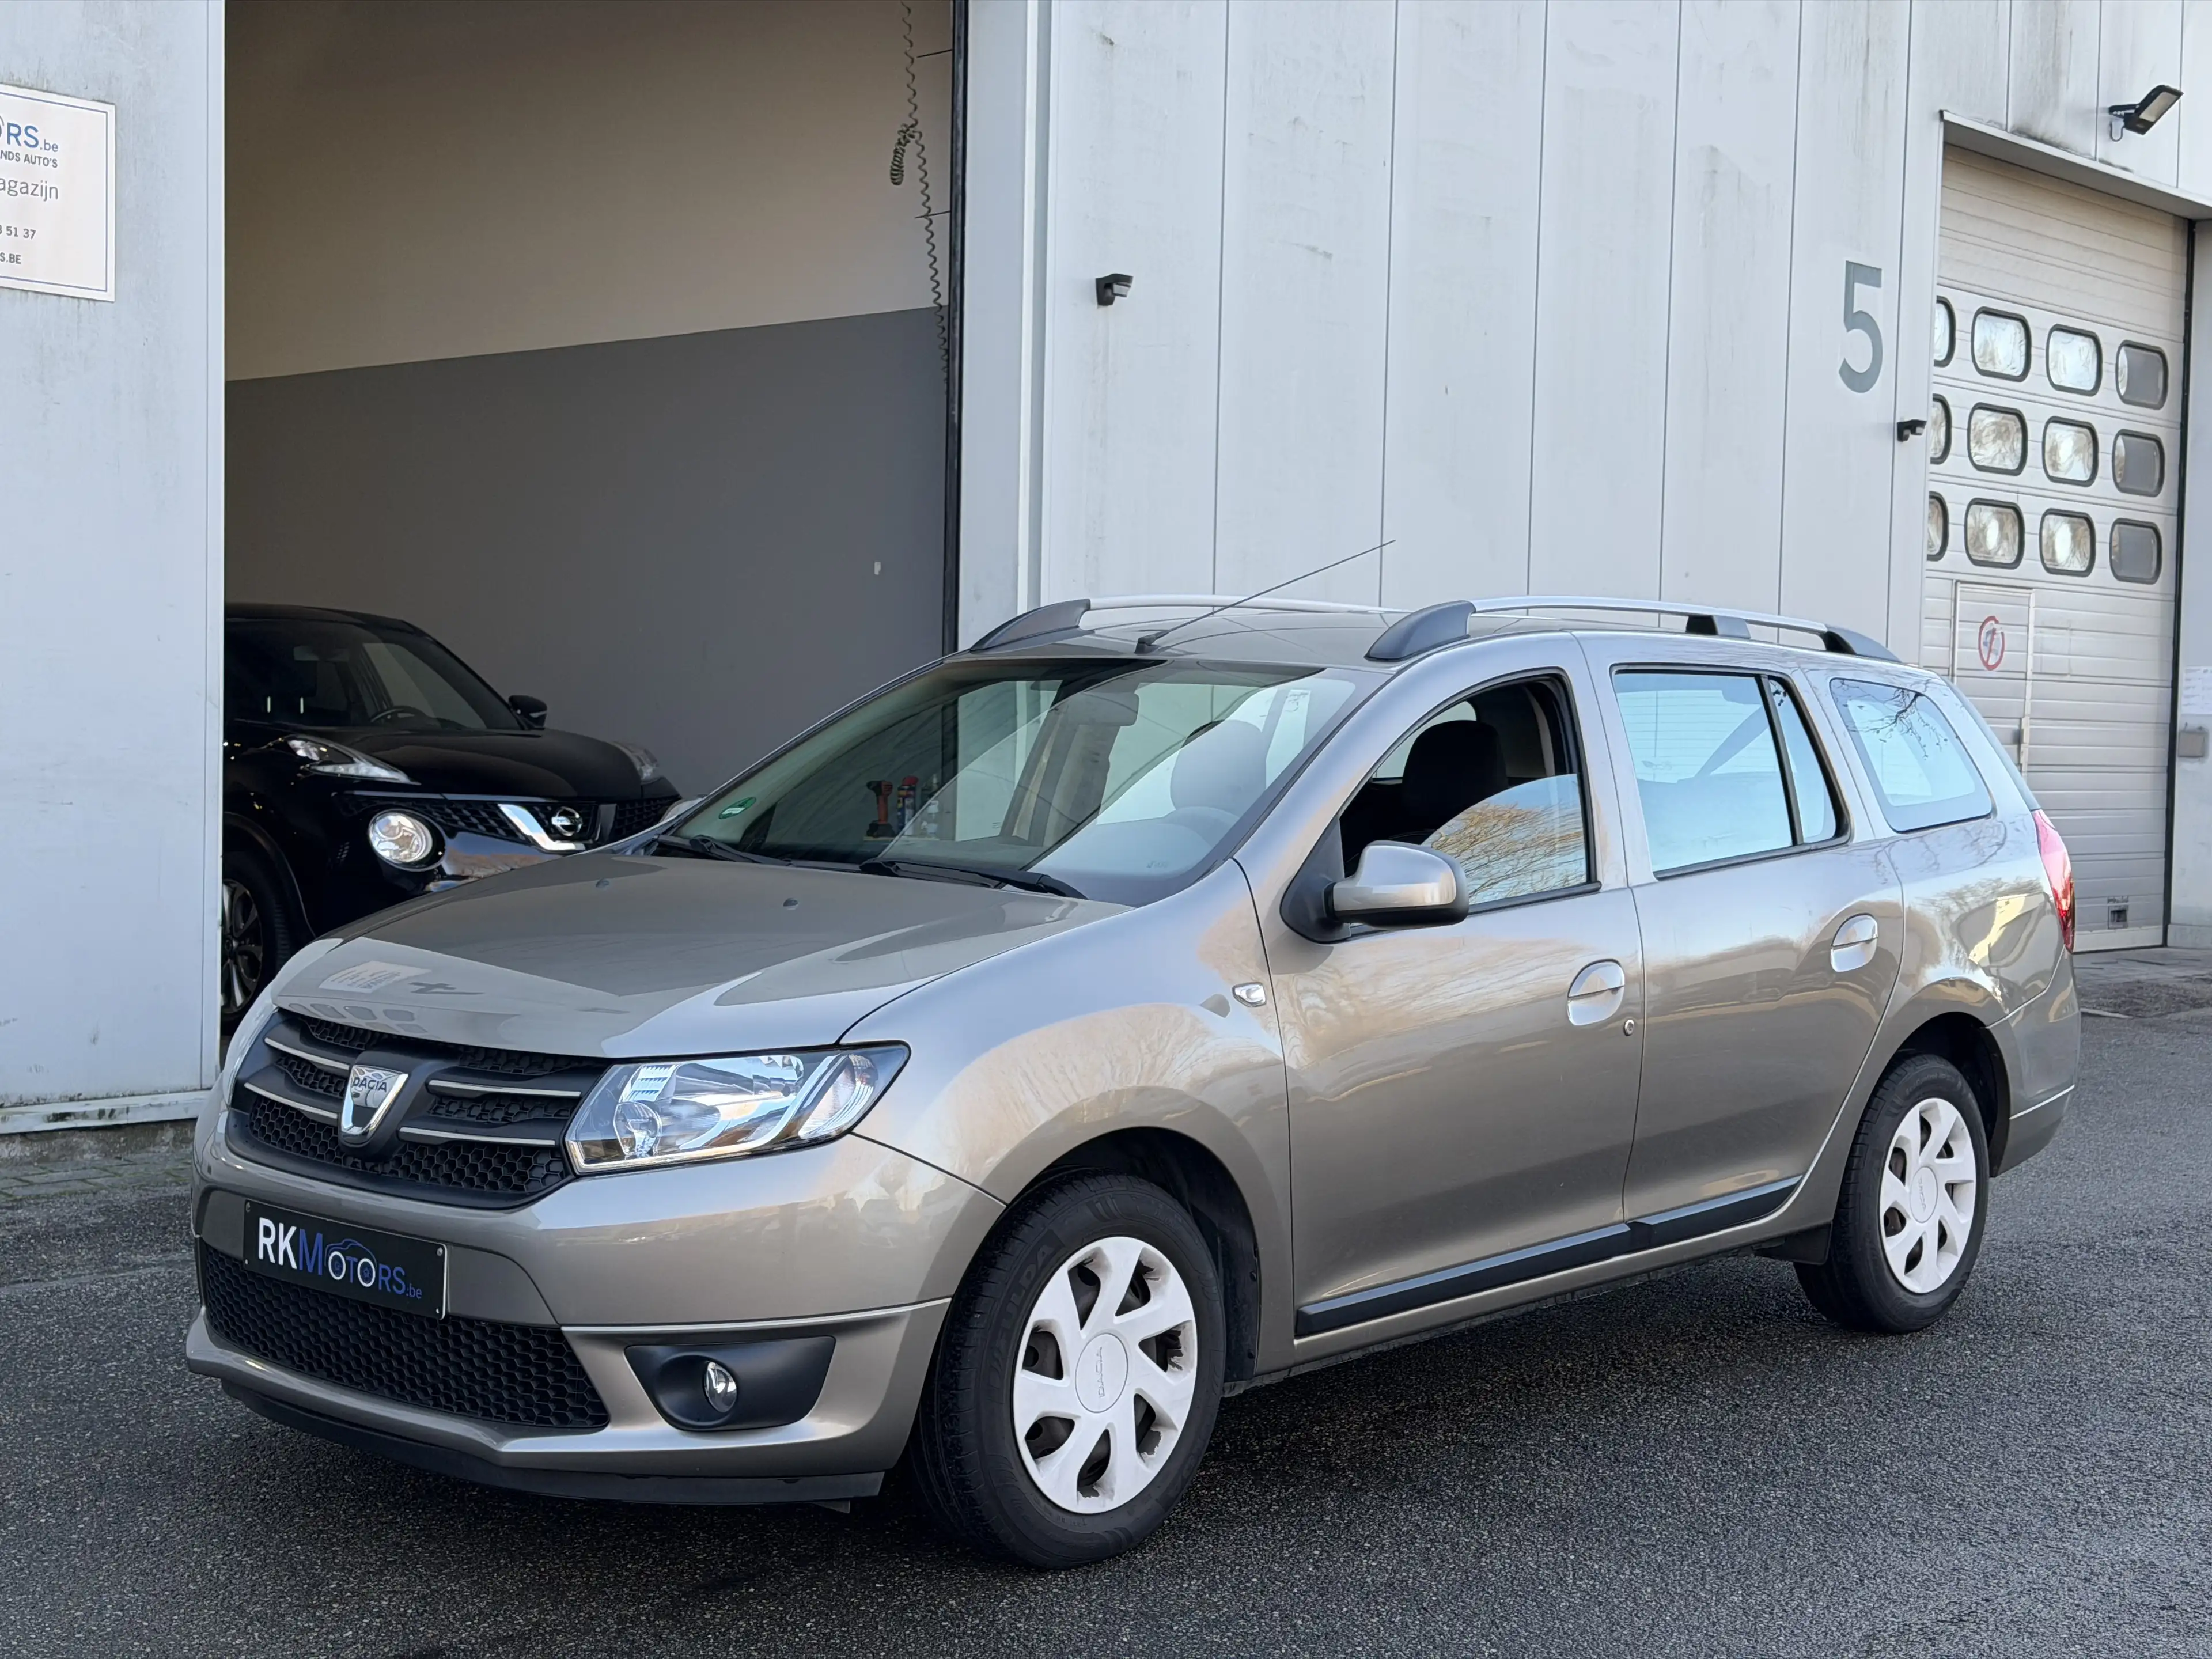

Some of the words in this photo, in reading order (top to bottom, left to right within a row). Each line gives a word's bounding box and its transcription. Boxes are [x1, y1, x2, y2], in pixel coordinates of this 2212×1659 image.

[0, 122, 59, 152] RS.be
[24, 154, 58, 168] AUTO'S
[6, 225, 18, 237] 51
[23, 228, 36, 240] 37
[1839, 260, 1883, 393] 5
[352, 1077, 387, 1093] DACIA
[1096, 1347, 1105, 1399] DACIA
